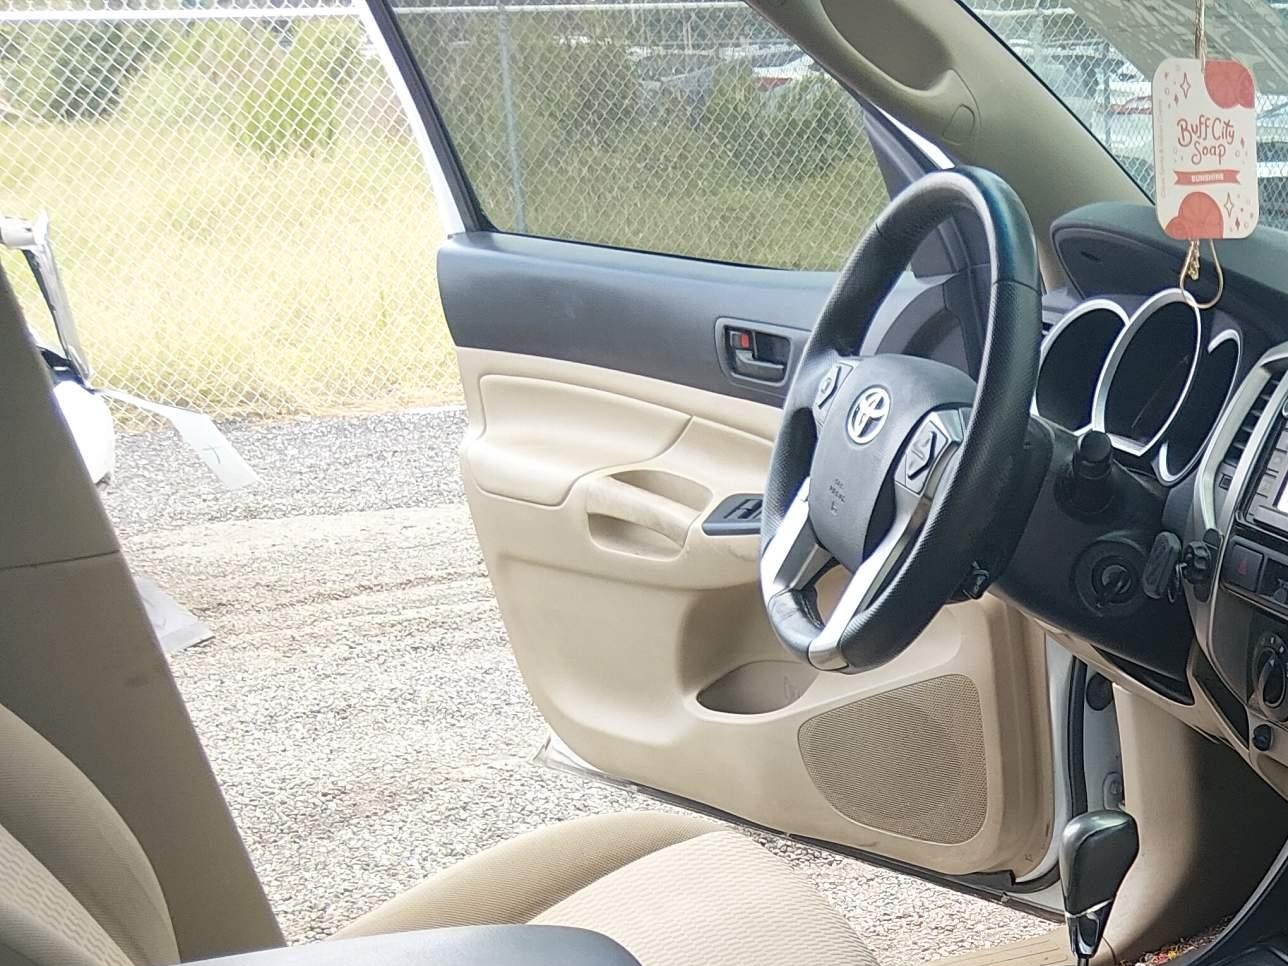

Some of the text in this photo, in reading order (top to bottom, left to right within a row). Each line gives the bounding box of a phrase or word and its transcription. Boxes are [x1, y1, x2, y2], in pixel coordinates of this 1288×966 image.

[1177, 114, 1235, 147] Buff City
[1191, 140, 1226, 165] Soap
